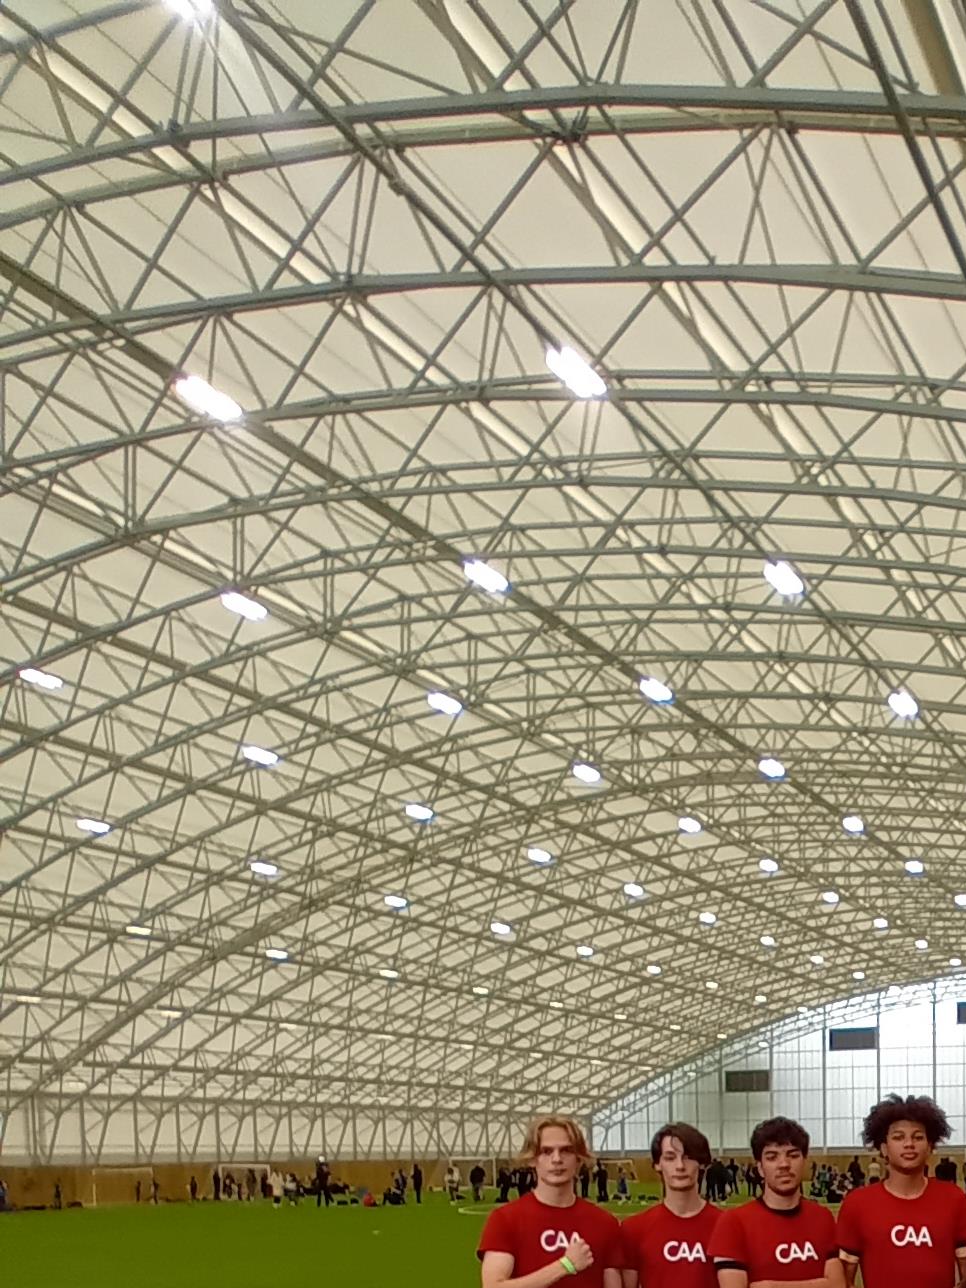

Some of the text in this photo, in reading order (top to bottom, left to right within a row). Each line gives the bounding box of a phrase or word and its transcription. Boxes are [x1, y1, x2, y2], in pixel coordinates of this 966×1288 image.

[890, 1224, 933, 1247] CAA
[663, 1240, 706, 1263] CAA
[775, 1241, 819, 1264] CAA
